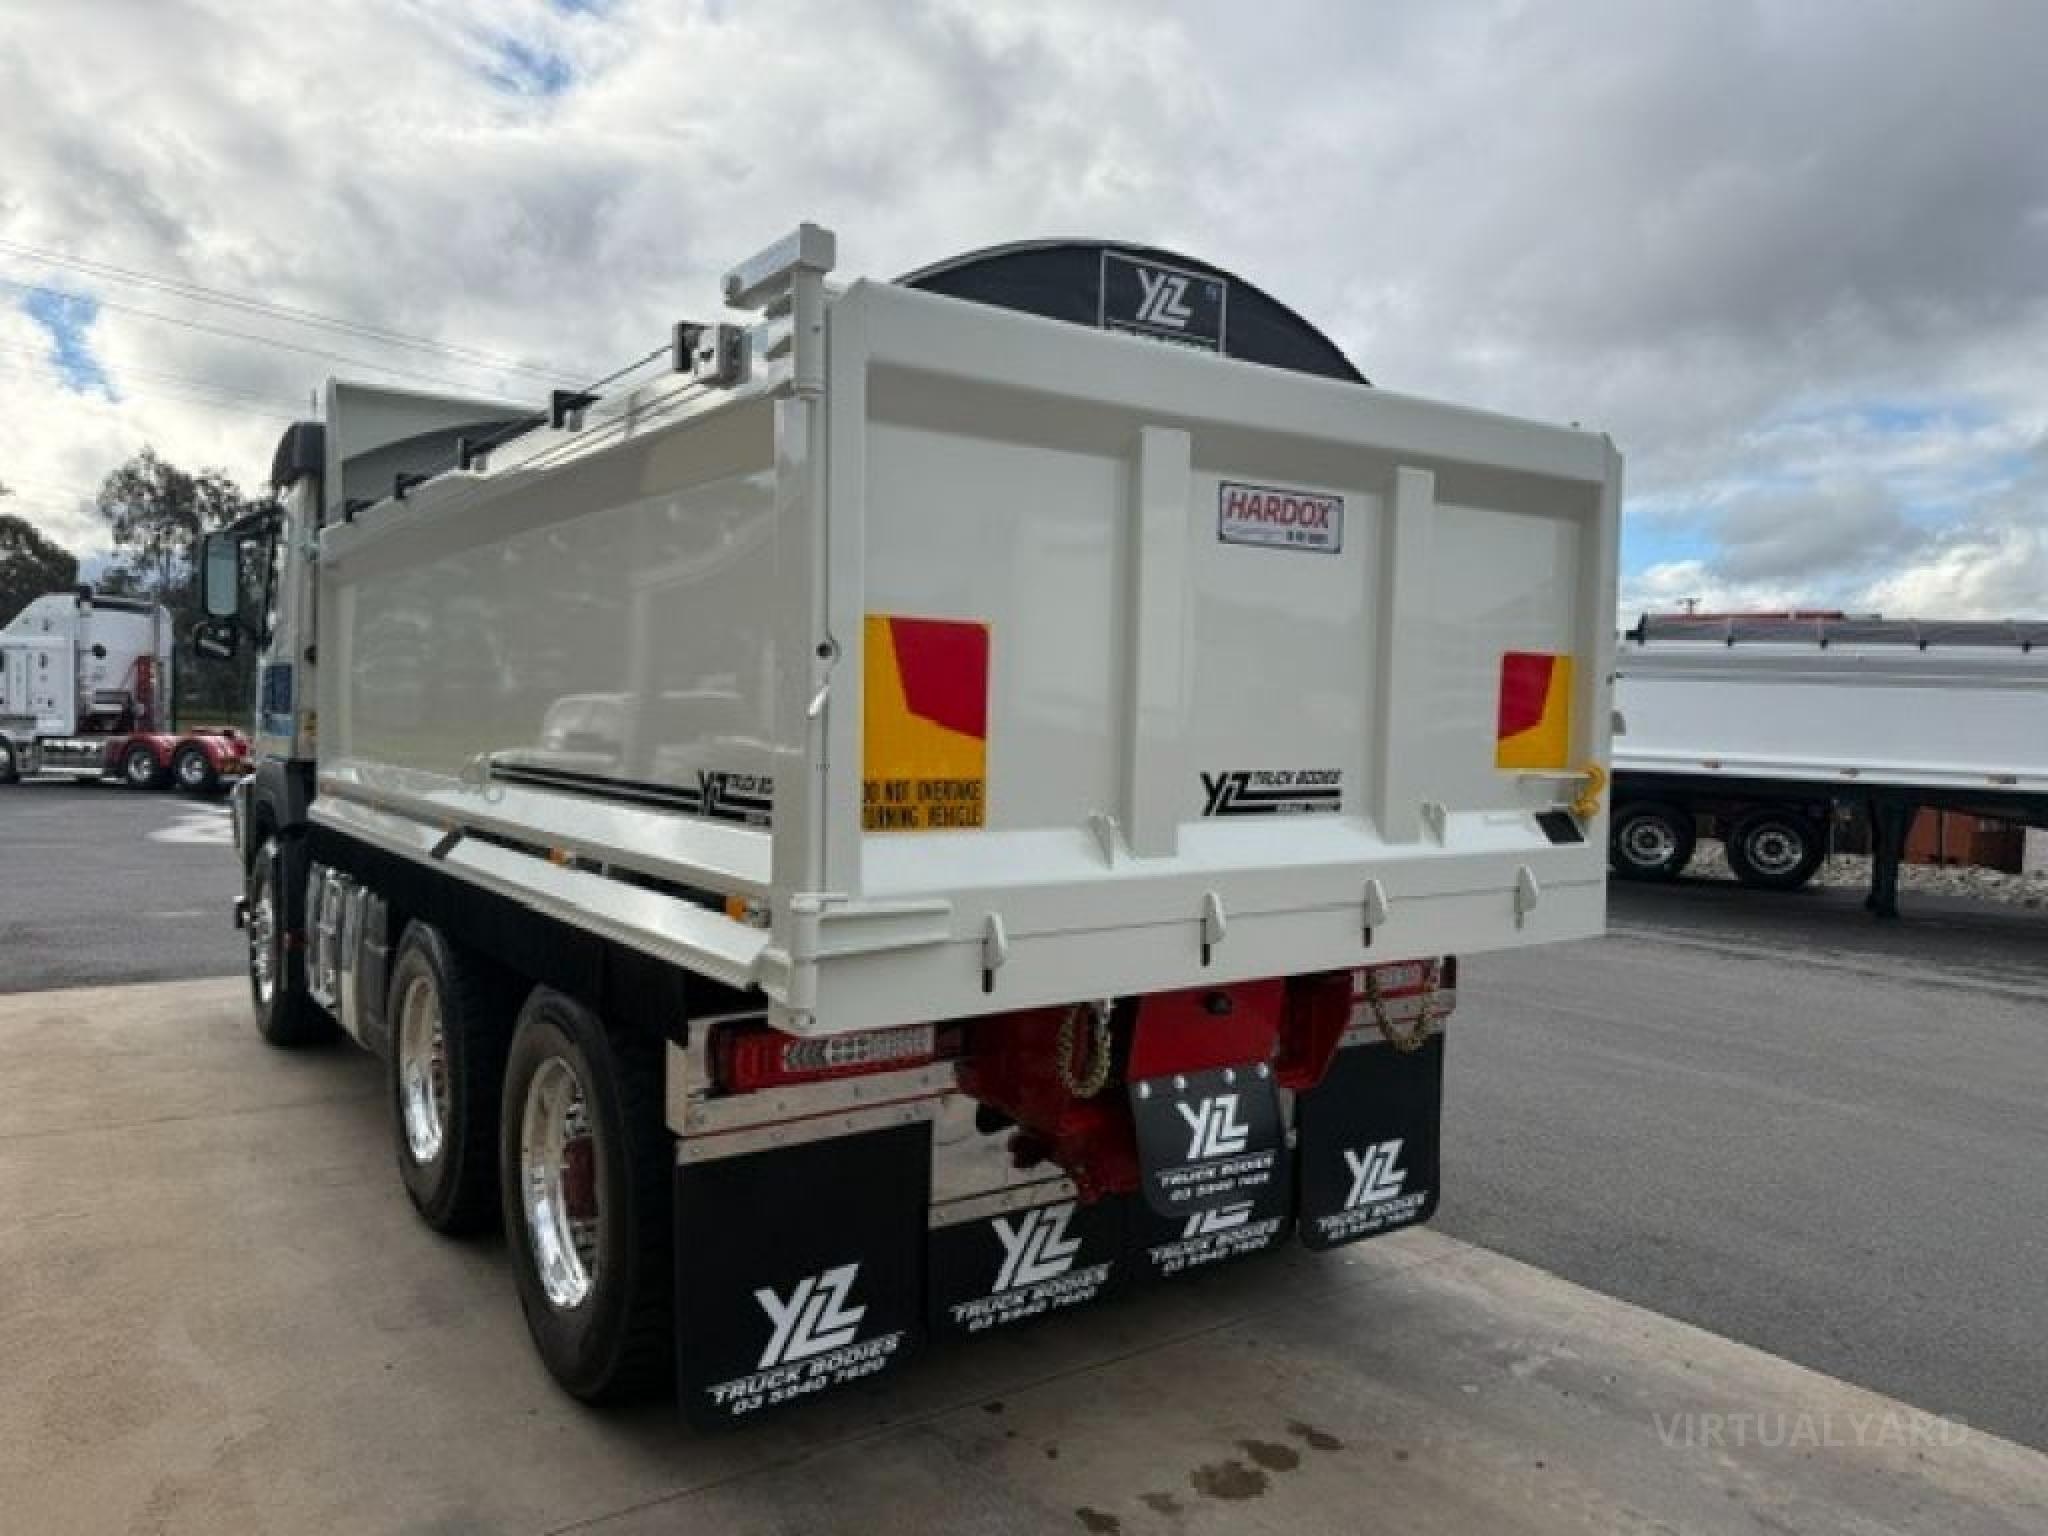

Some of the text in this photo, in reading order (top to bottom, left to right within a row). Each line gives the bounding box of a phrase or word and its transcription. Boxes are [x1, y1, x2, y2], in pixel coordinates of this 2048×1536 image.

[1225, 490, 1330, 529] HARDOX
[885, 779, 911, 801] NOT
[917, 779, 982, 801] OVERTAKE
[927, 804, 982, 827] VEHICLE
[1156, 1150, 1276, 1188] TRUCK BODIES
[1169, 1187, 1192, 1201] 03
[1150, 1238, 1209, 1265] TRUCK
[1215, 1217, 1283, 1249] BODIES
[949, 1260, 1115, 1323] TRUCK BODIES
[704, 1331, 906, 1406] TRUCK BODIES
[732, 1394, 763, 1416] 03
